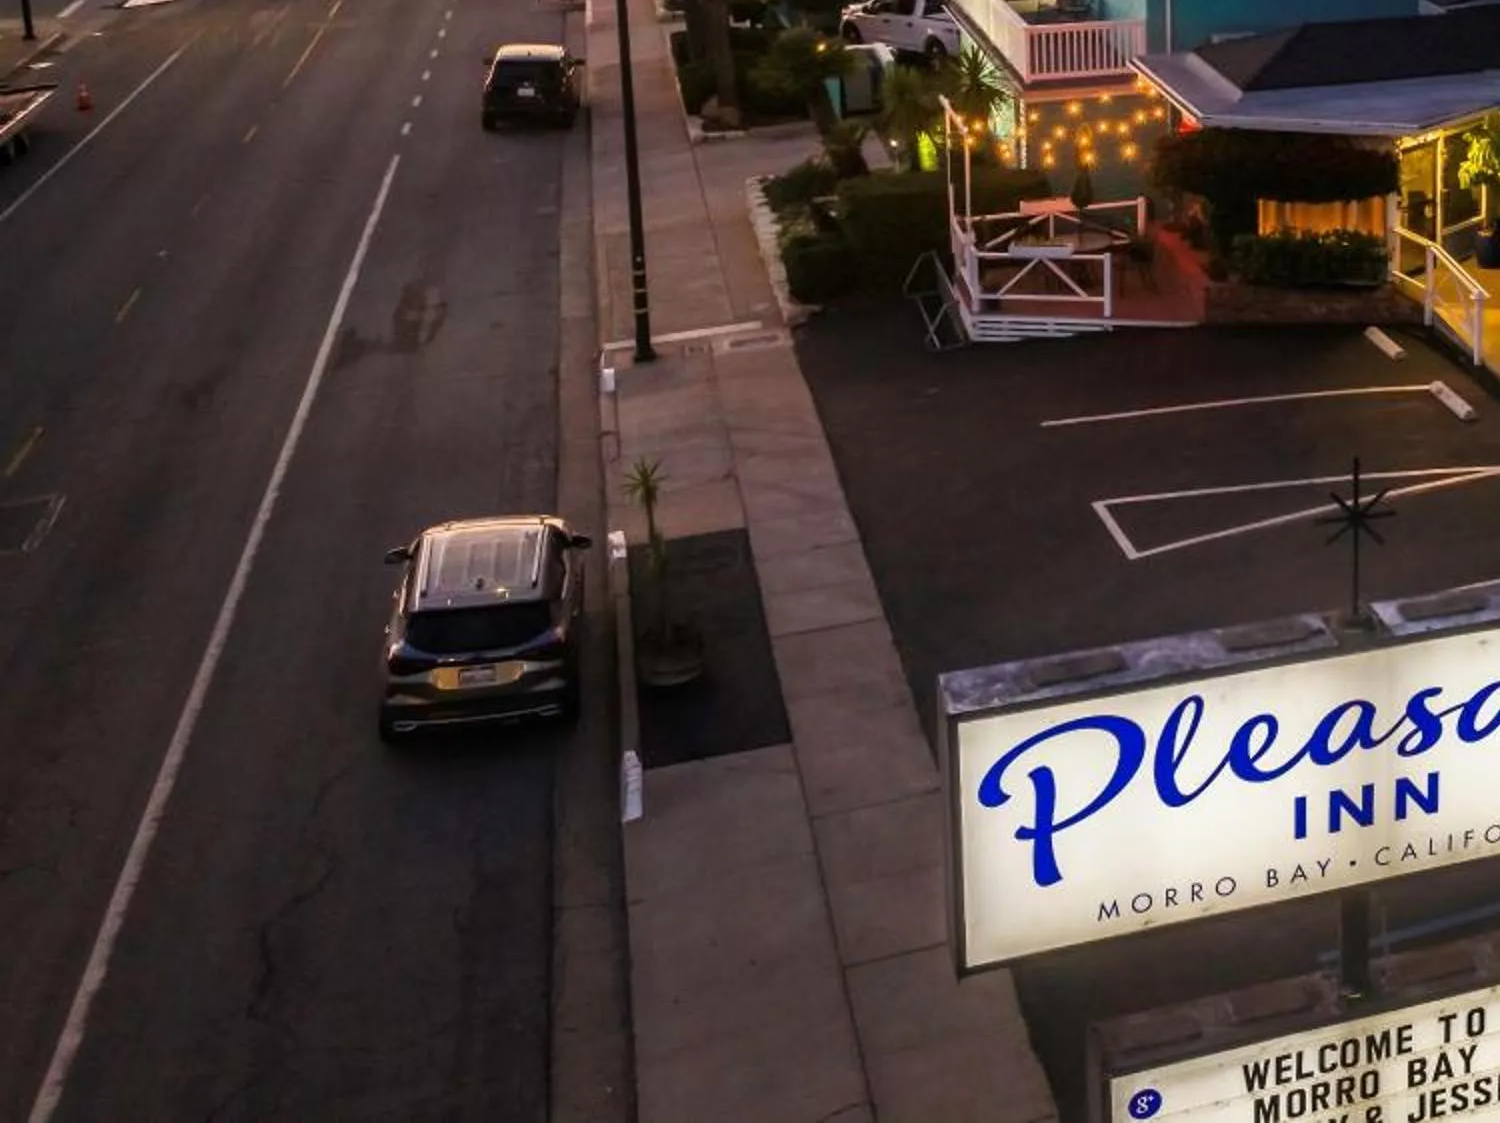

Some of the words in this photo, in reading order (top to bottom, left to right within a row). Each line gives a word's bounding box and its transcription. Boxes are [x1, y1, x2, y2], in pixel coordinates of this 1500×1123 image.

[1294, 771, 1440, 840] INN
[1097, 876, 1238, 922] MORRO
[1266, 857, 1332, 889] BAY
[1243, 1024, 1413, 1093] WELCOME
[1438, 1006, 1486, 1044] TO
[1254, 1069, 1380, 1123] MORRO
[1407, 1044, 1477, 1089] BAY
